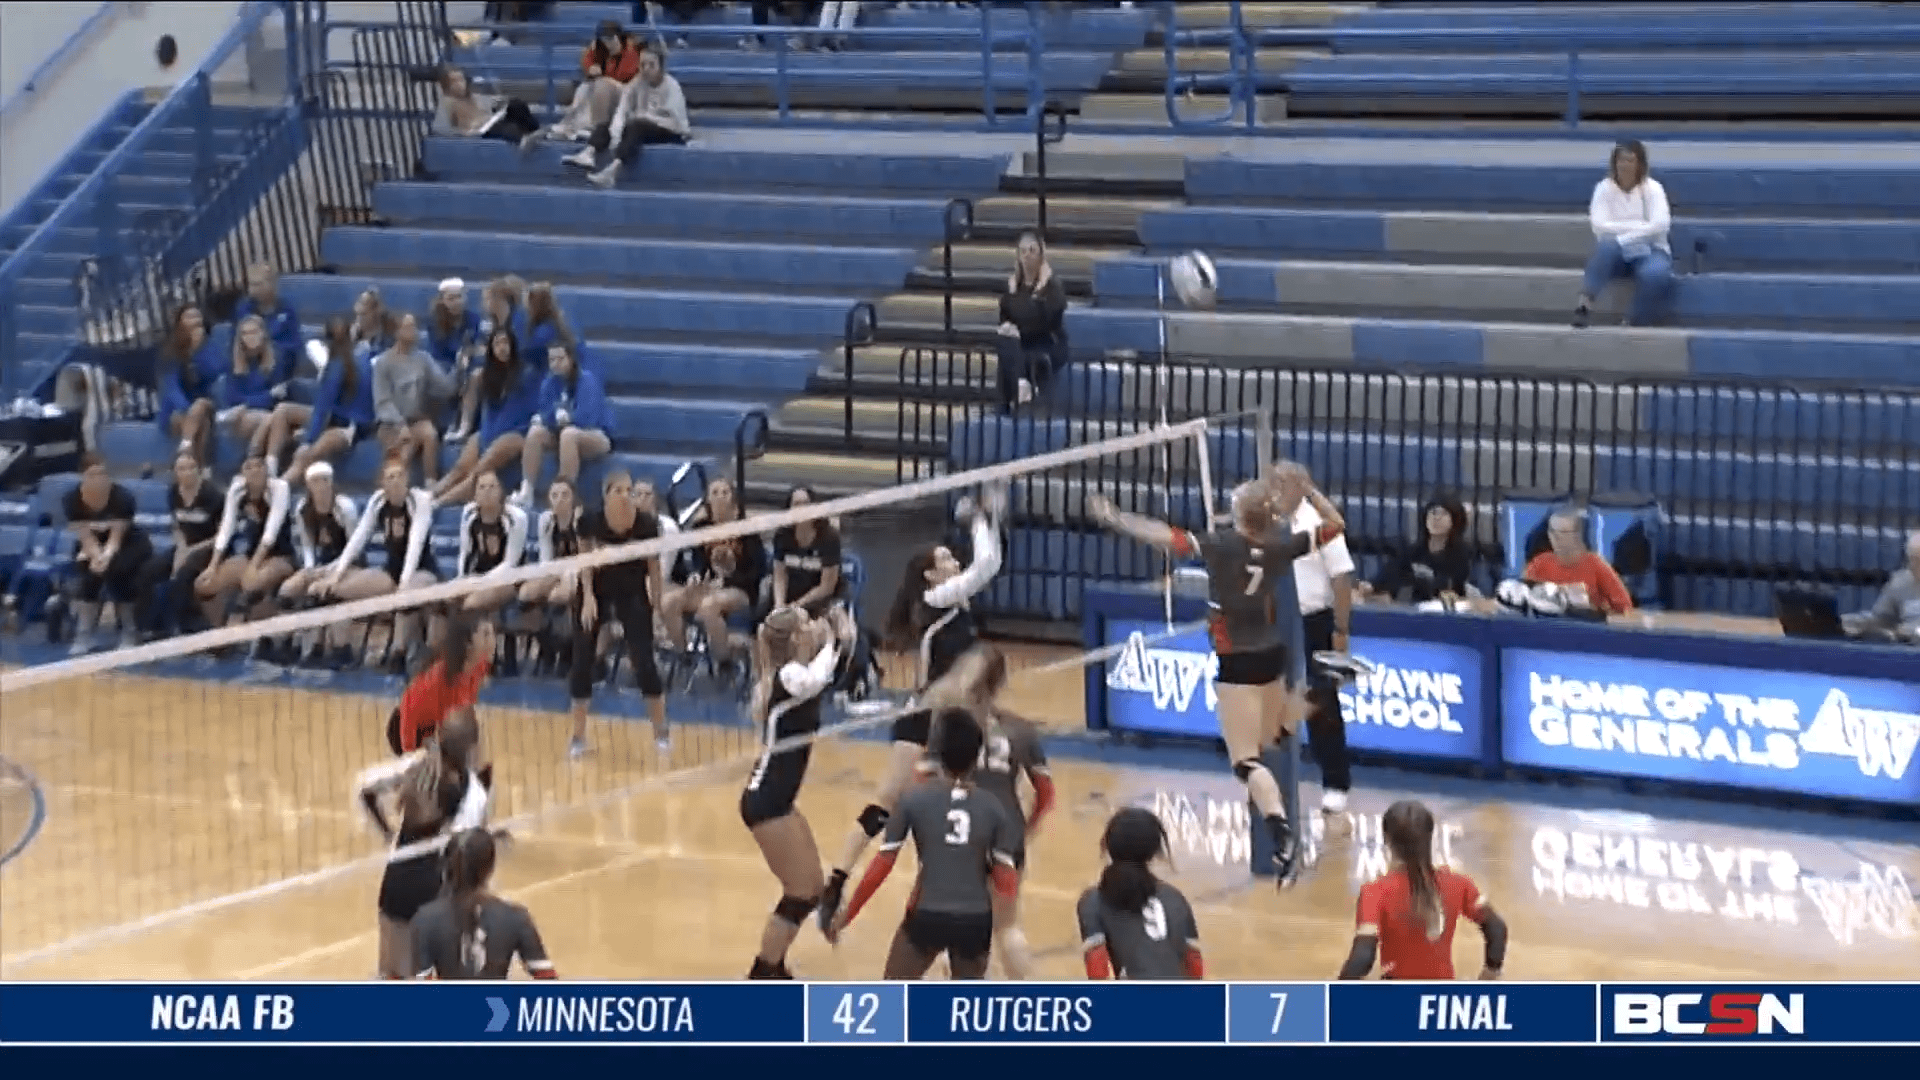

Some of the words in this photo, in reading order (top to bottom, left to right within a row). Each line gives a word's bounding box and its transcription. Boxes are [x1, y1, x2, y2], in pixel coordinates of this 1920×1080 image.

[1244, 564, 1264, 596] 7
[1337, 692, 1464, 733] CHOOL
[1529, 671, 1651, 717] HOME
[1654, 687, 1713, 722] OF
[1713, 693, 1800, 731] THE
[1529, 705, 1800, 769] GENERALS
[945, 809, 971, 845] 3
[1142, 897, 1167, 942] 9
